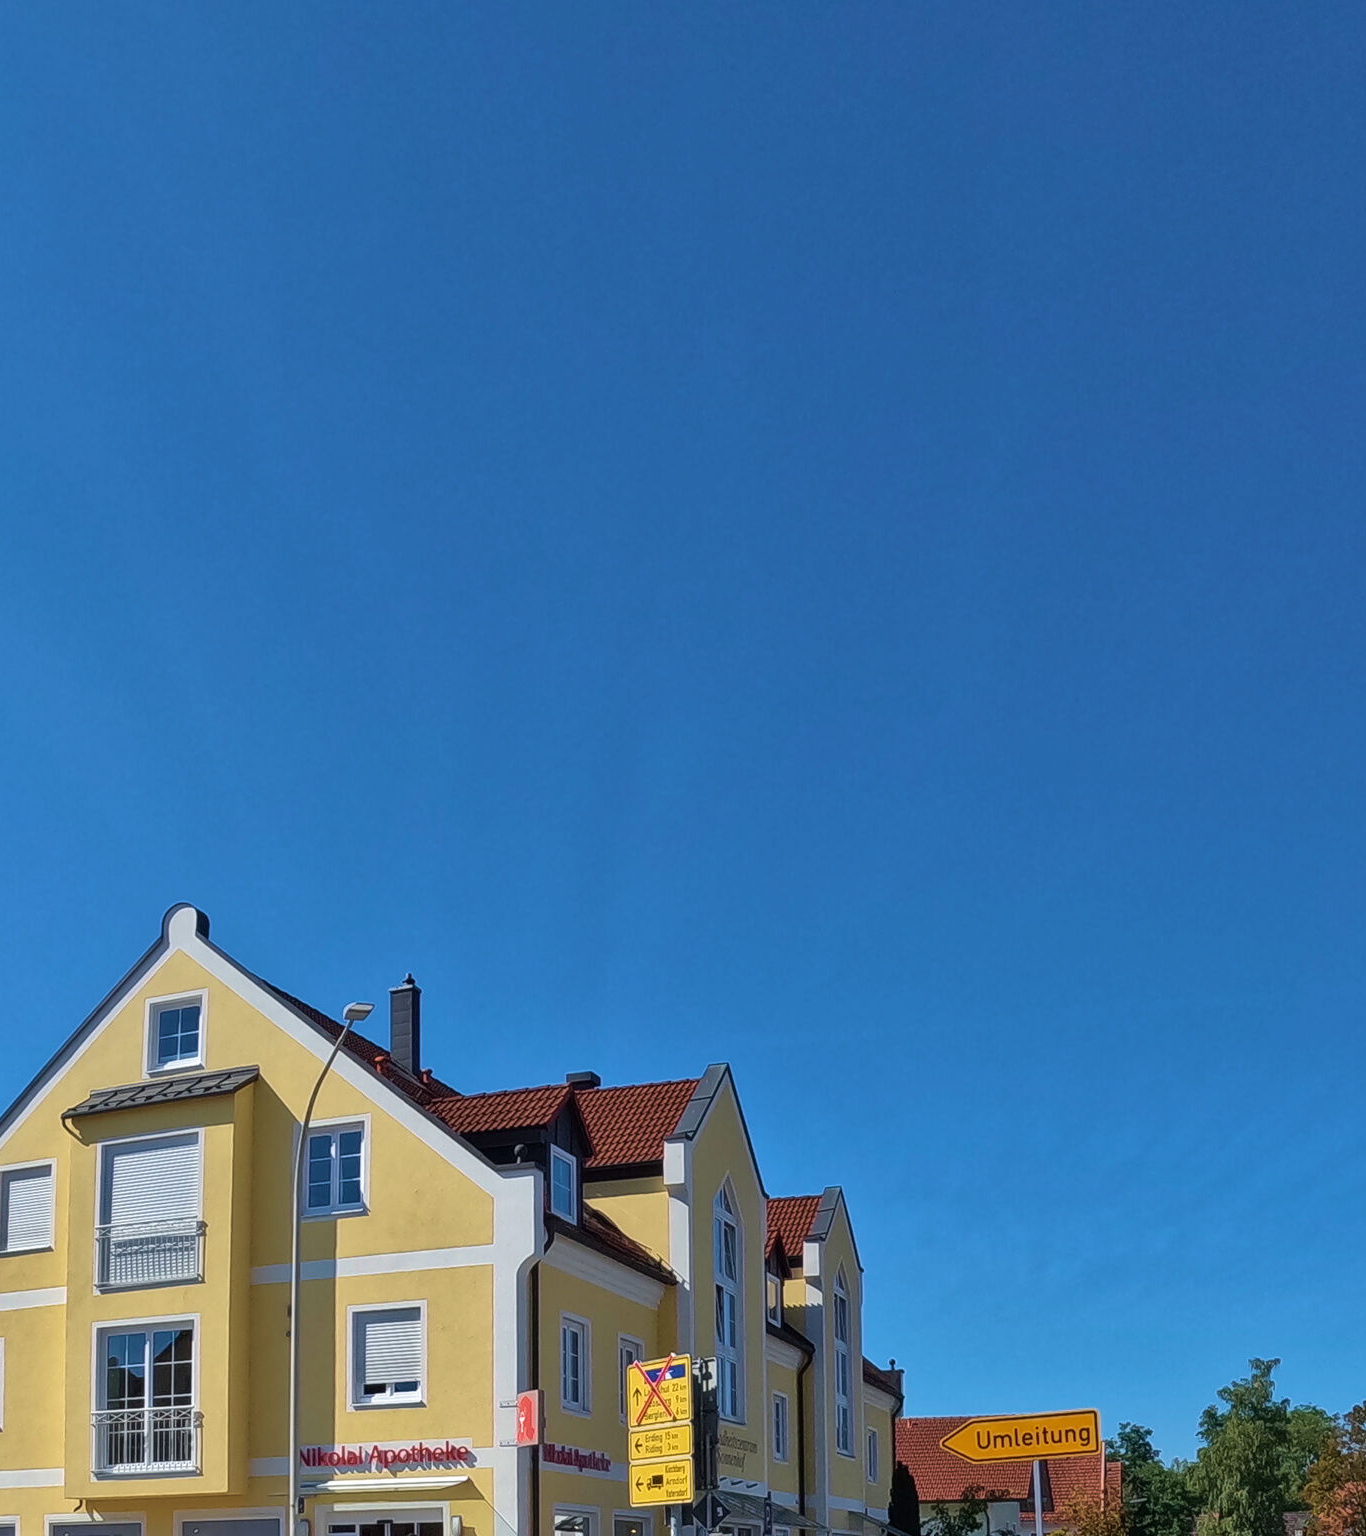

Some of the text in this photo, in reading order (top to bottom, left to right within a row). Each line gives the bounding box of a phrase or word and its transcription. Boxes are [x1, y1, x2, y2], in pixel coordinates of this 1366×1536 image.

[645, 1433, 663, 1443] Erding
[665, 1431, 671, 1440] 15
[976, 1426, 1090, 1450] Umleitung
[299, 1441, 469, 1468] Nikolai Apotheke
